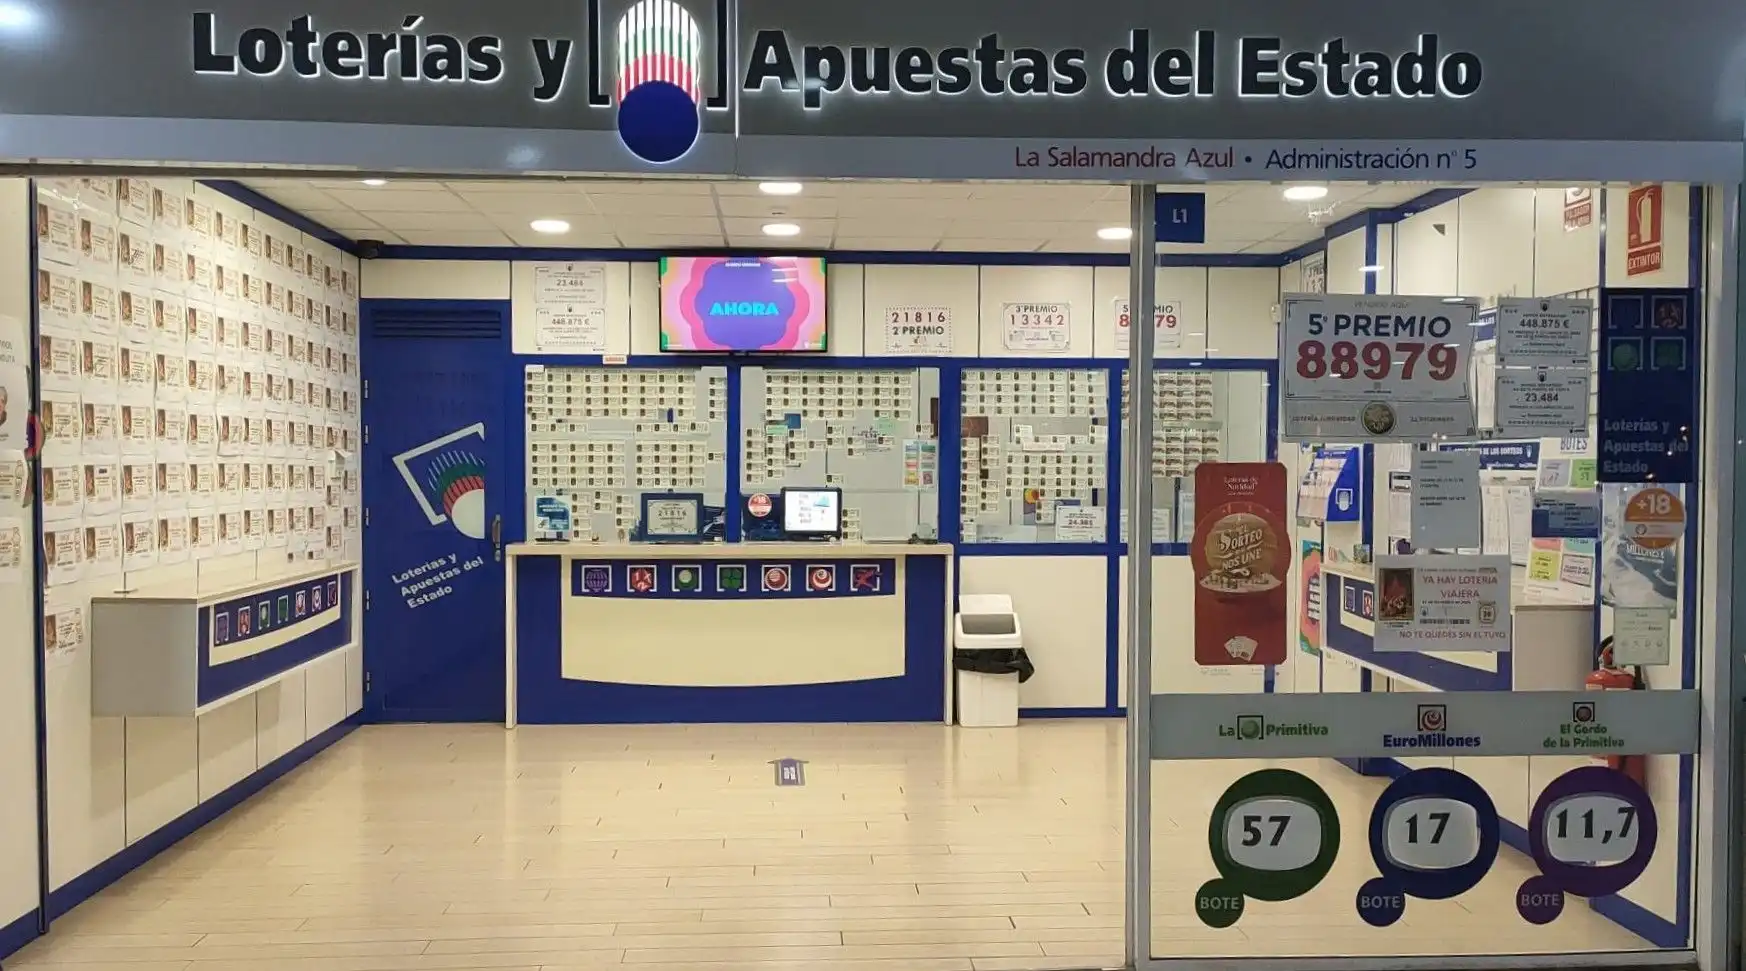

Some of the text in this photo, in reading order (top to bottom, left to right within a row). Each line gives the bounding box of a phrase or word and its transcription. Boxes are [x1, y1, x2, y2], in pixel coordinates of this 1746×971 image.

[192, 12, 573, 101] Loterías y
[743, 29, 1482, 110] Apuestas del Estado
[1015, 146, 1040, 167] La
[1047, 146, 1176, 168] Salamandra
[1184, 146, 1234, 168] Azul
[1265, 147, 1429, 170] Administración
[1464, 149, 1477, 169] 5
[1172, 208, 1188, 223] L1
[1628, 252, 1660, 269] EXTINTOR
[710, 302, 779, 316] AHORA
[1024, 305, 1058, 313] PREMIO
[902, 325, 945, 335] PREMIO
[1334, 313, 1452, 338] PREMIO
[1519, 319, 1570, 329] 448.875 €
[1296, 339, 1458, 381] 88979
[1524, 392, 1559, 402] 23.484
[1603, 418, 1670, 434] Loterías y
[1603, 438, 1665, 455] Apuestas
[1603, 460, 1649, 473] Estado
[1636, 494, 1672, 514] +18
[448, 553, 457, 564] y
[401, 555, 484, 597] Apuestas del
[1422, 575, 1435, 584] YA
[1437, 575, 1457, 584] HAY
[406, 585, 453, 609] Estado
[1440, 589, 1480, 598] VIAJERA
[1400, 631, 1413, 639] NO
[1425, 631, 1458, 639] QUEDES
[1459, 631, 1472, 639] SIN
[1484, 631, 1506, 639] TUYO
[1219, 723, 1328, 736] La Primitiva
[1560, 724, 1607, 734] El Gordo
[1383, 733, 1481, 748] EuroMillones
[1543, 736, 1625, 748] de la Primitiva
[1242, 815, 1291, 847] 57
[1405, 812, 1451, 844] 17
[1556, 807, 1637, 845] 11,7
[1199, 897, 1241, 910] BOTE
[1360, 895, 1401, 909] BOTE
[1520, 894, 1560, 908] BOTE
